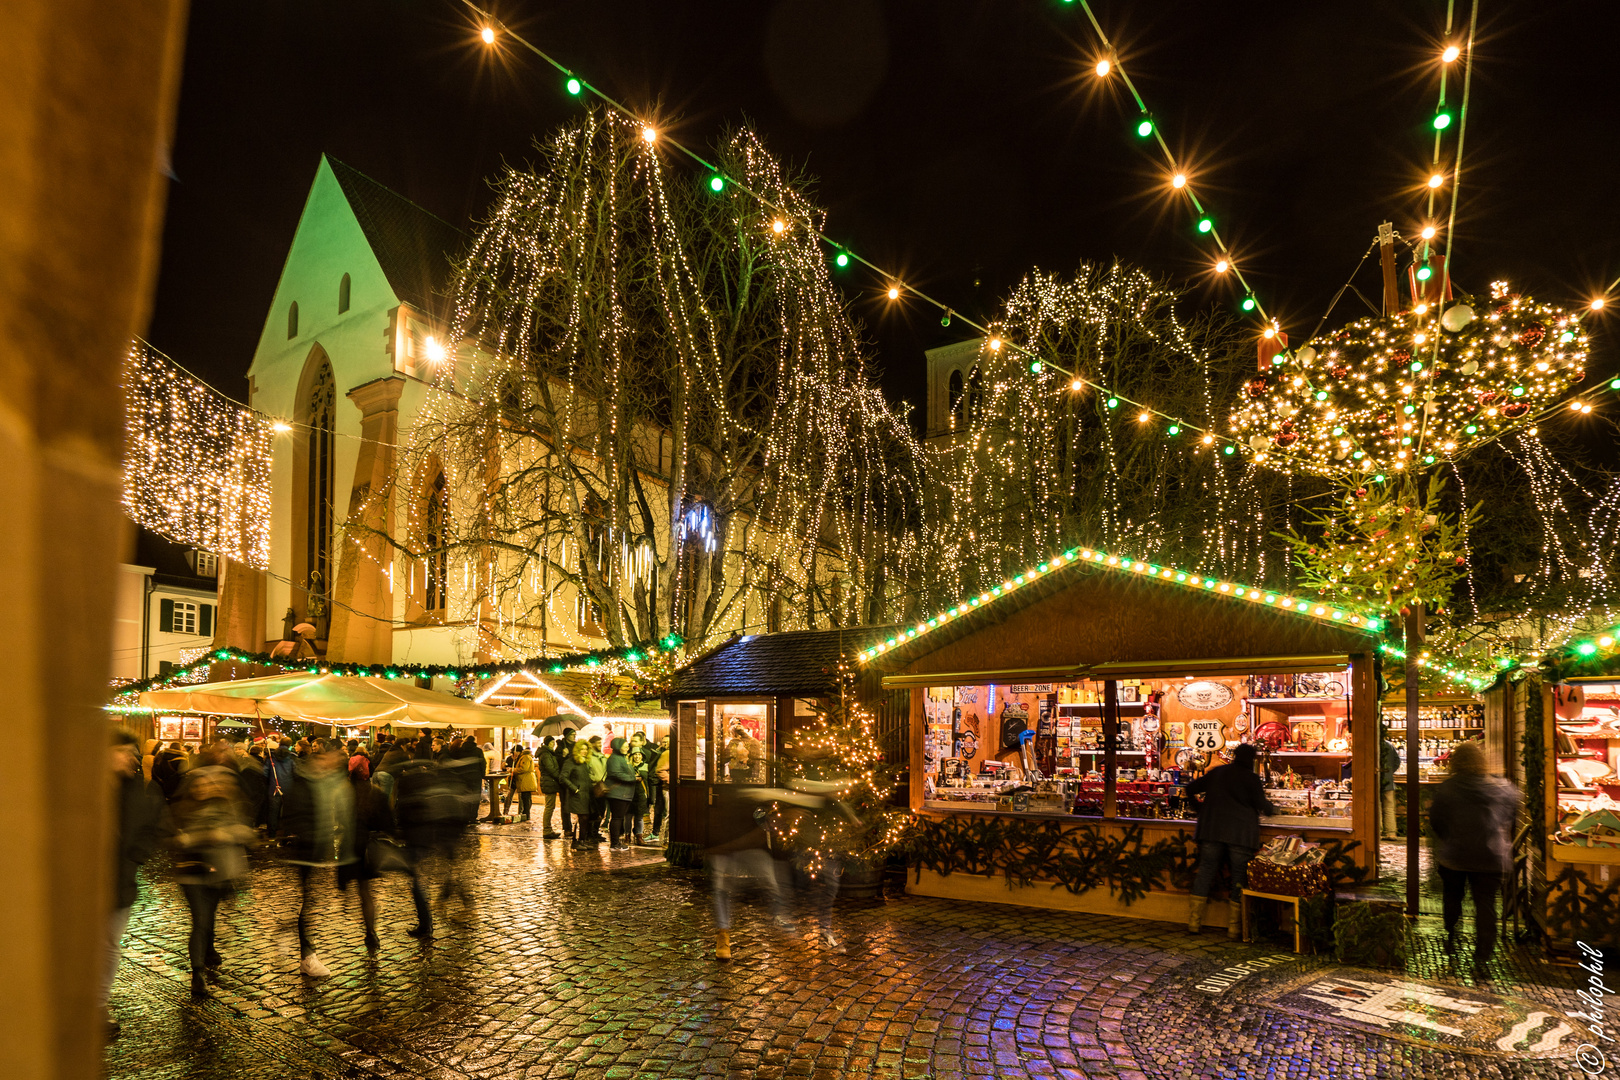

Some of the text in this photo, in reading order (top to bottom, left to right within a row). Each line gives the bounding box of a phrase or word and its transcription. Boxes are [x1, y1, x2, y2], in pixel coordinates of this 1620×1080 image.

[1034, 684, 1051, 692] ZONE
[1195, 736, 1217, 749] 66
[1194, 954, 1296, 993] GUILDFORD
